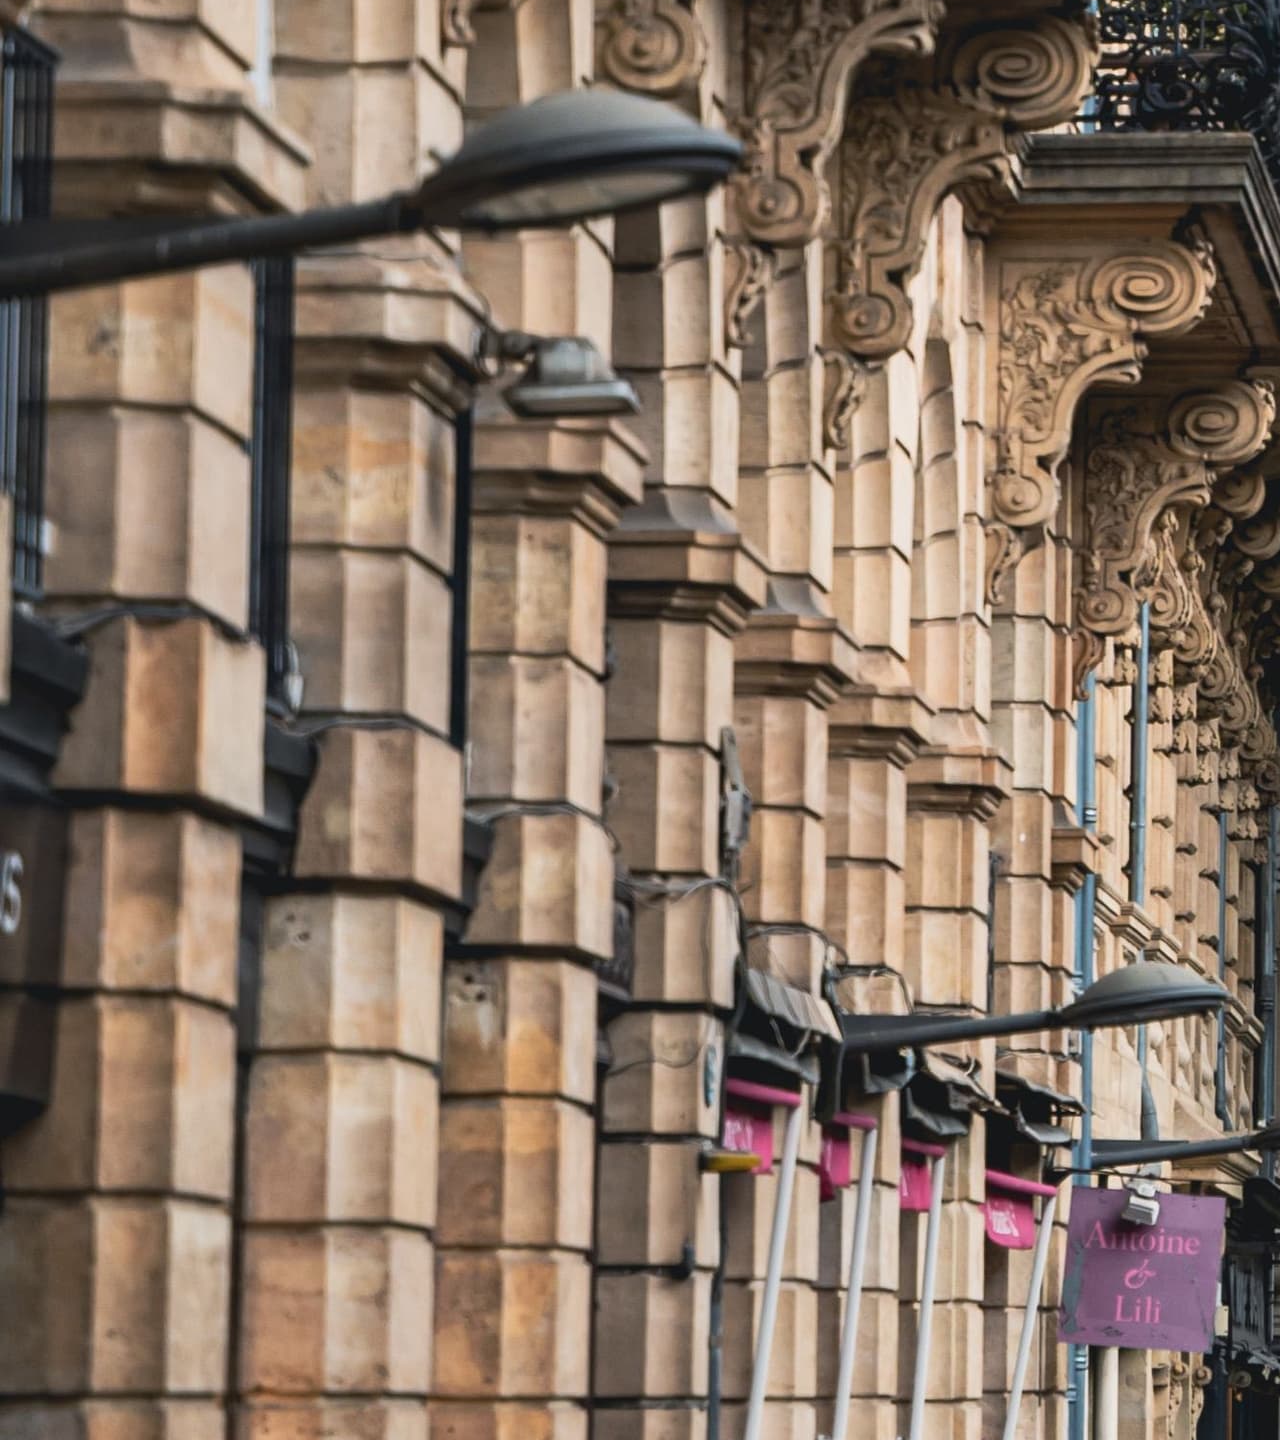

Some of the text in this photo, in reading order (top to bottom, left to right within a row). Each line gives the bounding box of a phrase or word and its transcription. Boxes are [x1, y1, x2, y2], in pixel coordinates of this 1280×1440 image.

[1085, 1220, 1200, 1256] Antoine
[1124, 1259, 1157, 1289] &
[1115, 1295, 1162, 1324] Lili
